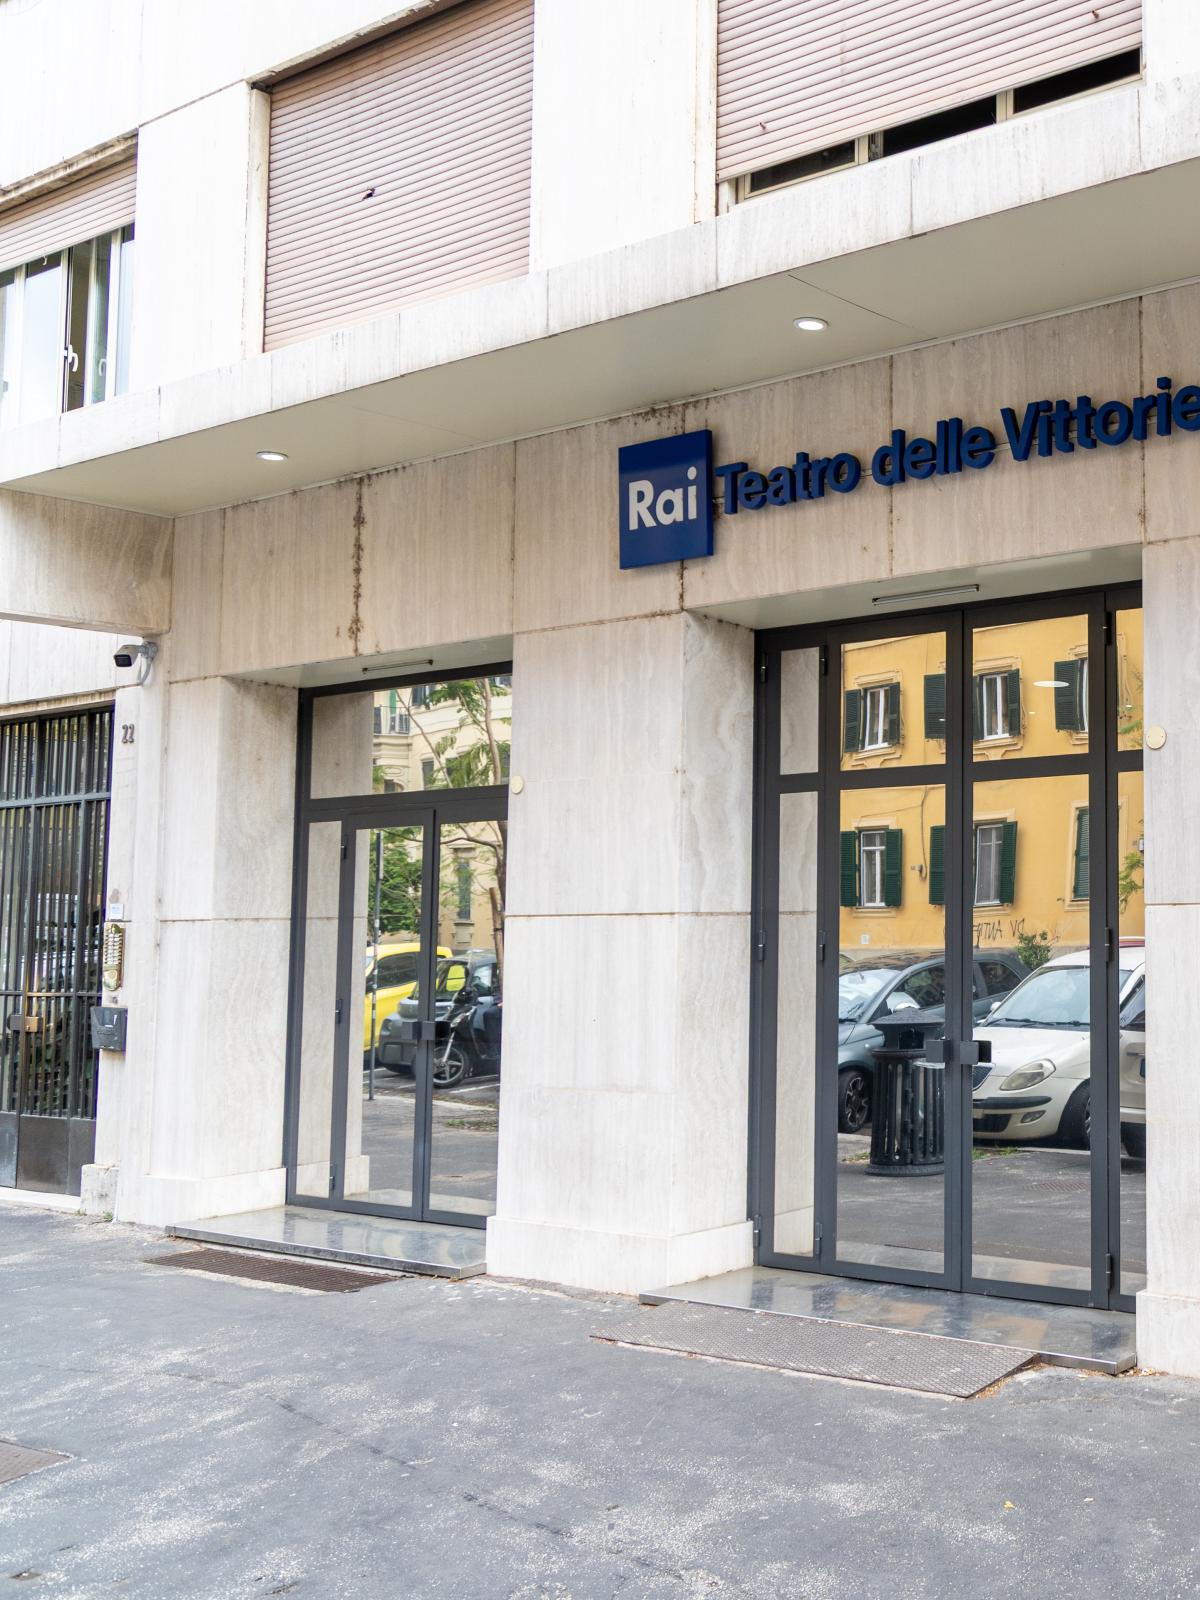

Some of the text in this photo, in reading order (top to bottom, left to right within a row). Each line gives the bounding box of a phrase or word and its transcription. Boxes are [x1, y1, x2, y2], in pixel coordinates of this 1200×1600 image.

[716, 451, 862, 515] Teatro
[871, 416, 996, 486] delle
[628, 466, 698, 530] Rai
[121, 723, 135, 744] 22
